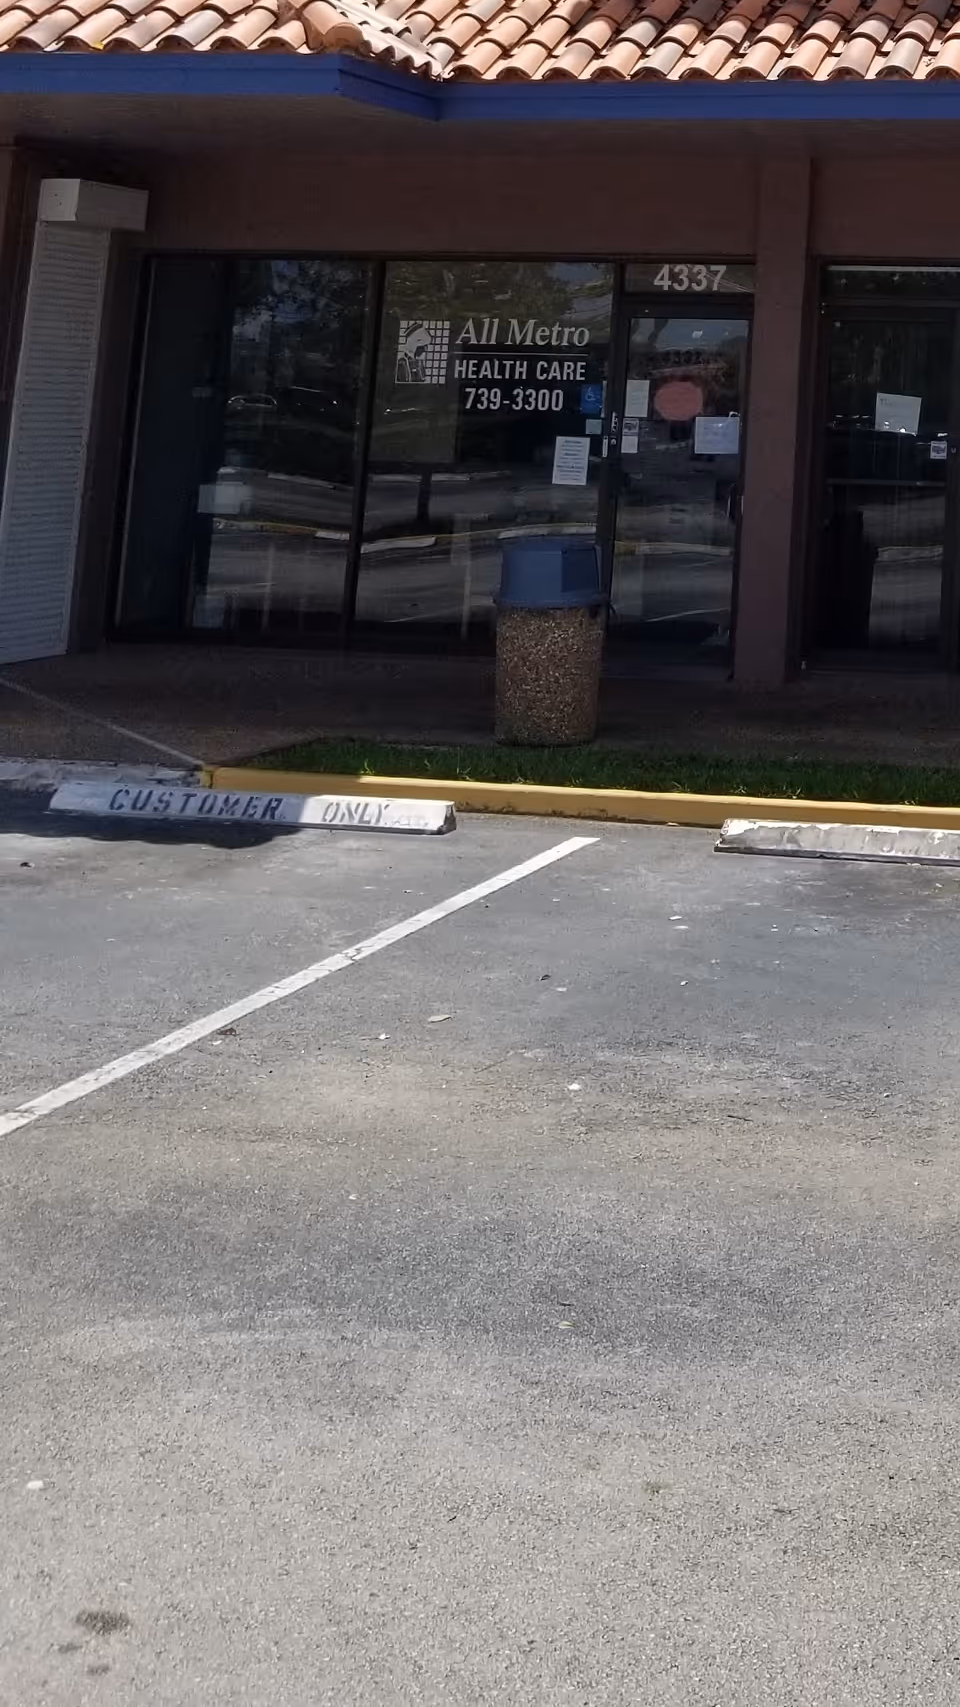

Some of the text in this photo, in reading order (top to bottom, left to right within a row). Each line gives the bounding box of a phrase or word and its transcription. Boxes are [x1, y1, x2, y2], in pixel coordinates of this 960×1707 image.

[653, 264, 727, 292] 4337
[454, 317, 590, 347] All Metro
[454, 358, 586, 381] HEALTH CARE
[464, 386, 564, 412] 739-3300
[109, 789, 284, 820] CUSTOMER
[320, 801, 389, 825] ONLY
